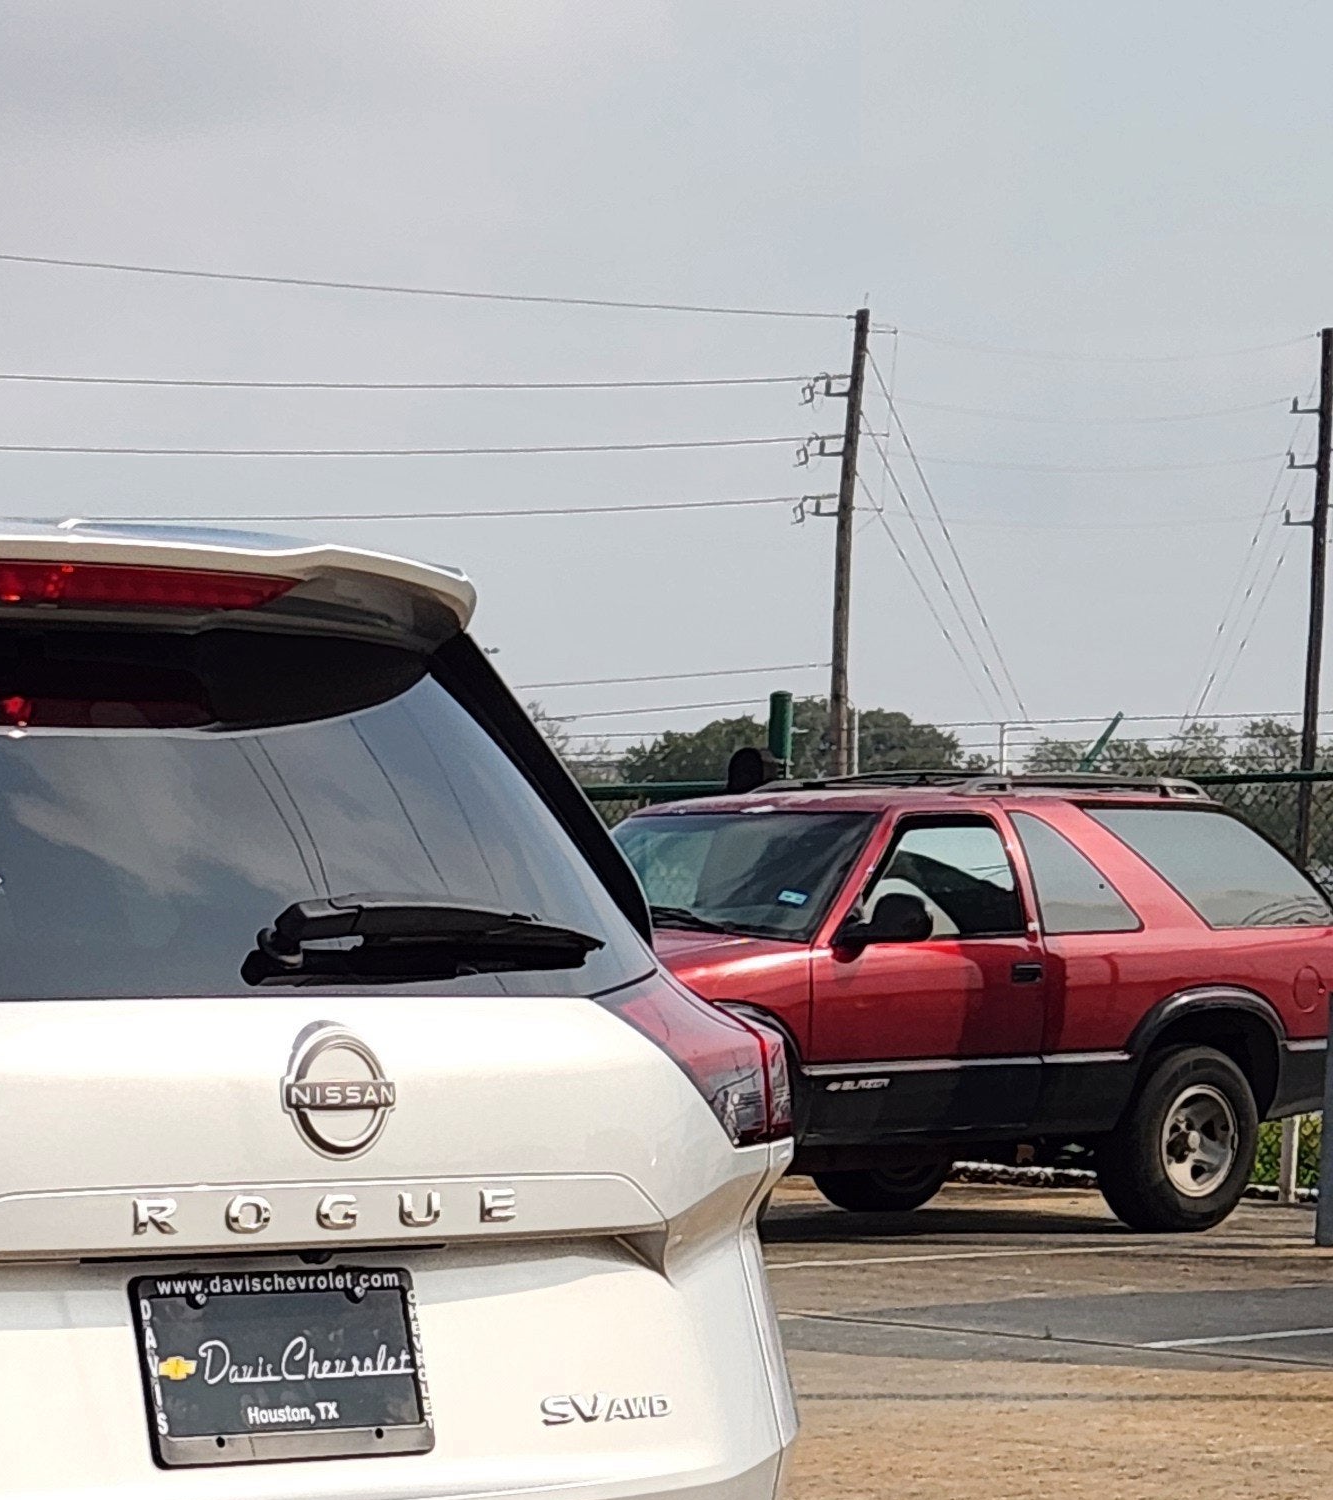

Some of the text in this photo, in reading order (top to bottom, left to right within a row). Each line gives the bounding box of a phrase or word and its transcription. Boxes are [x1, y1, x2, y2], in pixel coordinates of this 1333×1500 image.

[290, 1085, 395, 1104] NISSAN
[132, 1187, 517, 1236] ROGUE
[156, 1271, 400, 1296] www.davischevrolet.com
[139, 1299, 169, 1435] DAVIS
[198, 1336, 415, 1385] Davis Chevrolet
[247, 1401, 340, 1425] Houston, TX
[539, 1391, 673, 1427] SV AWD
